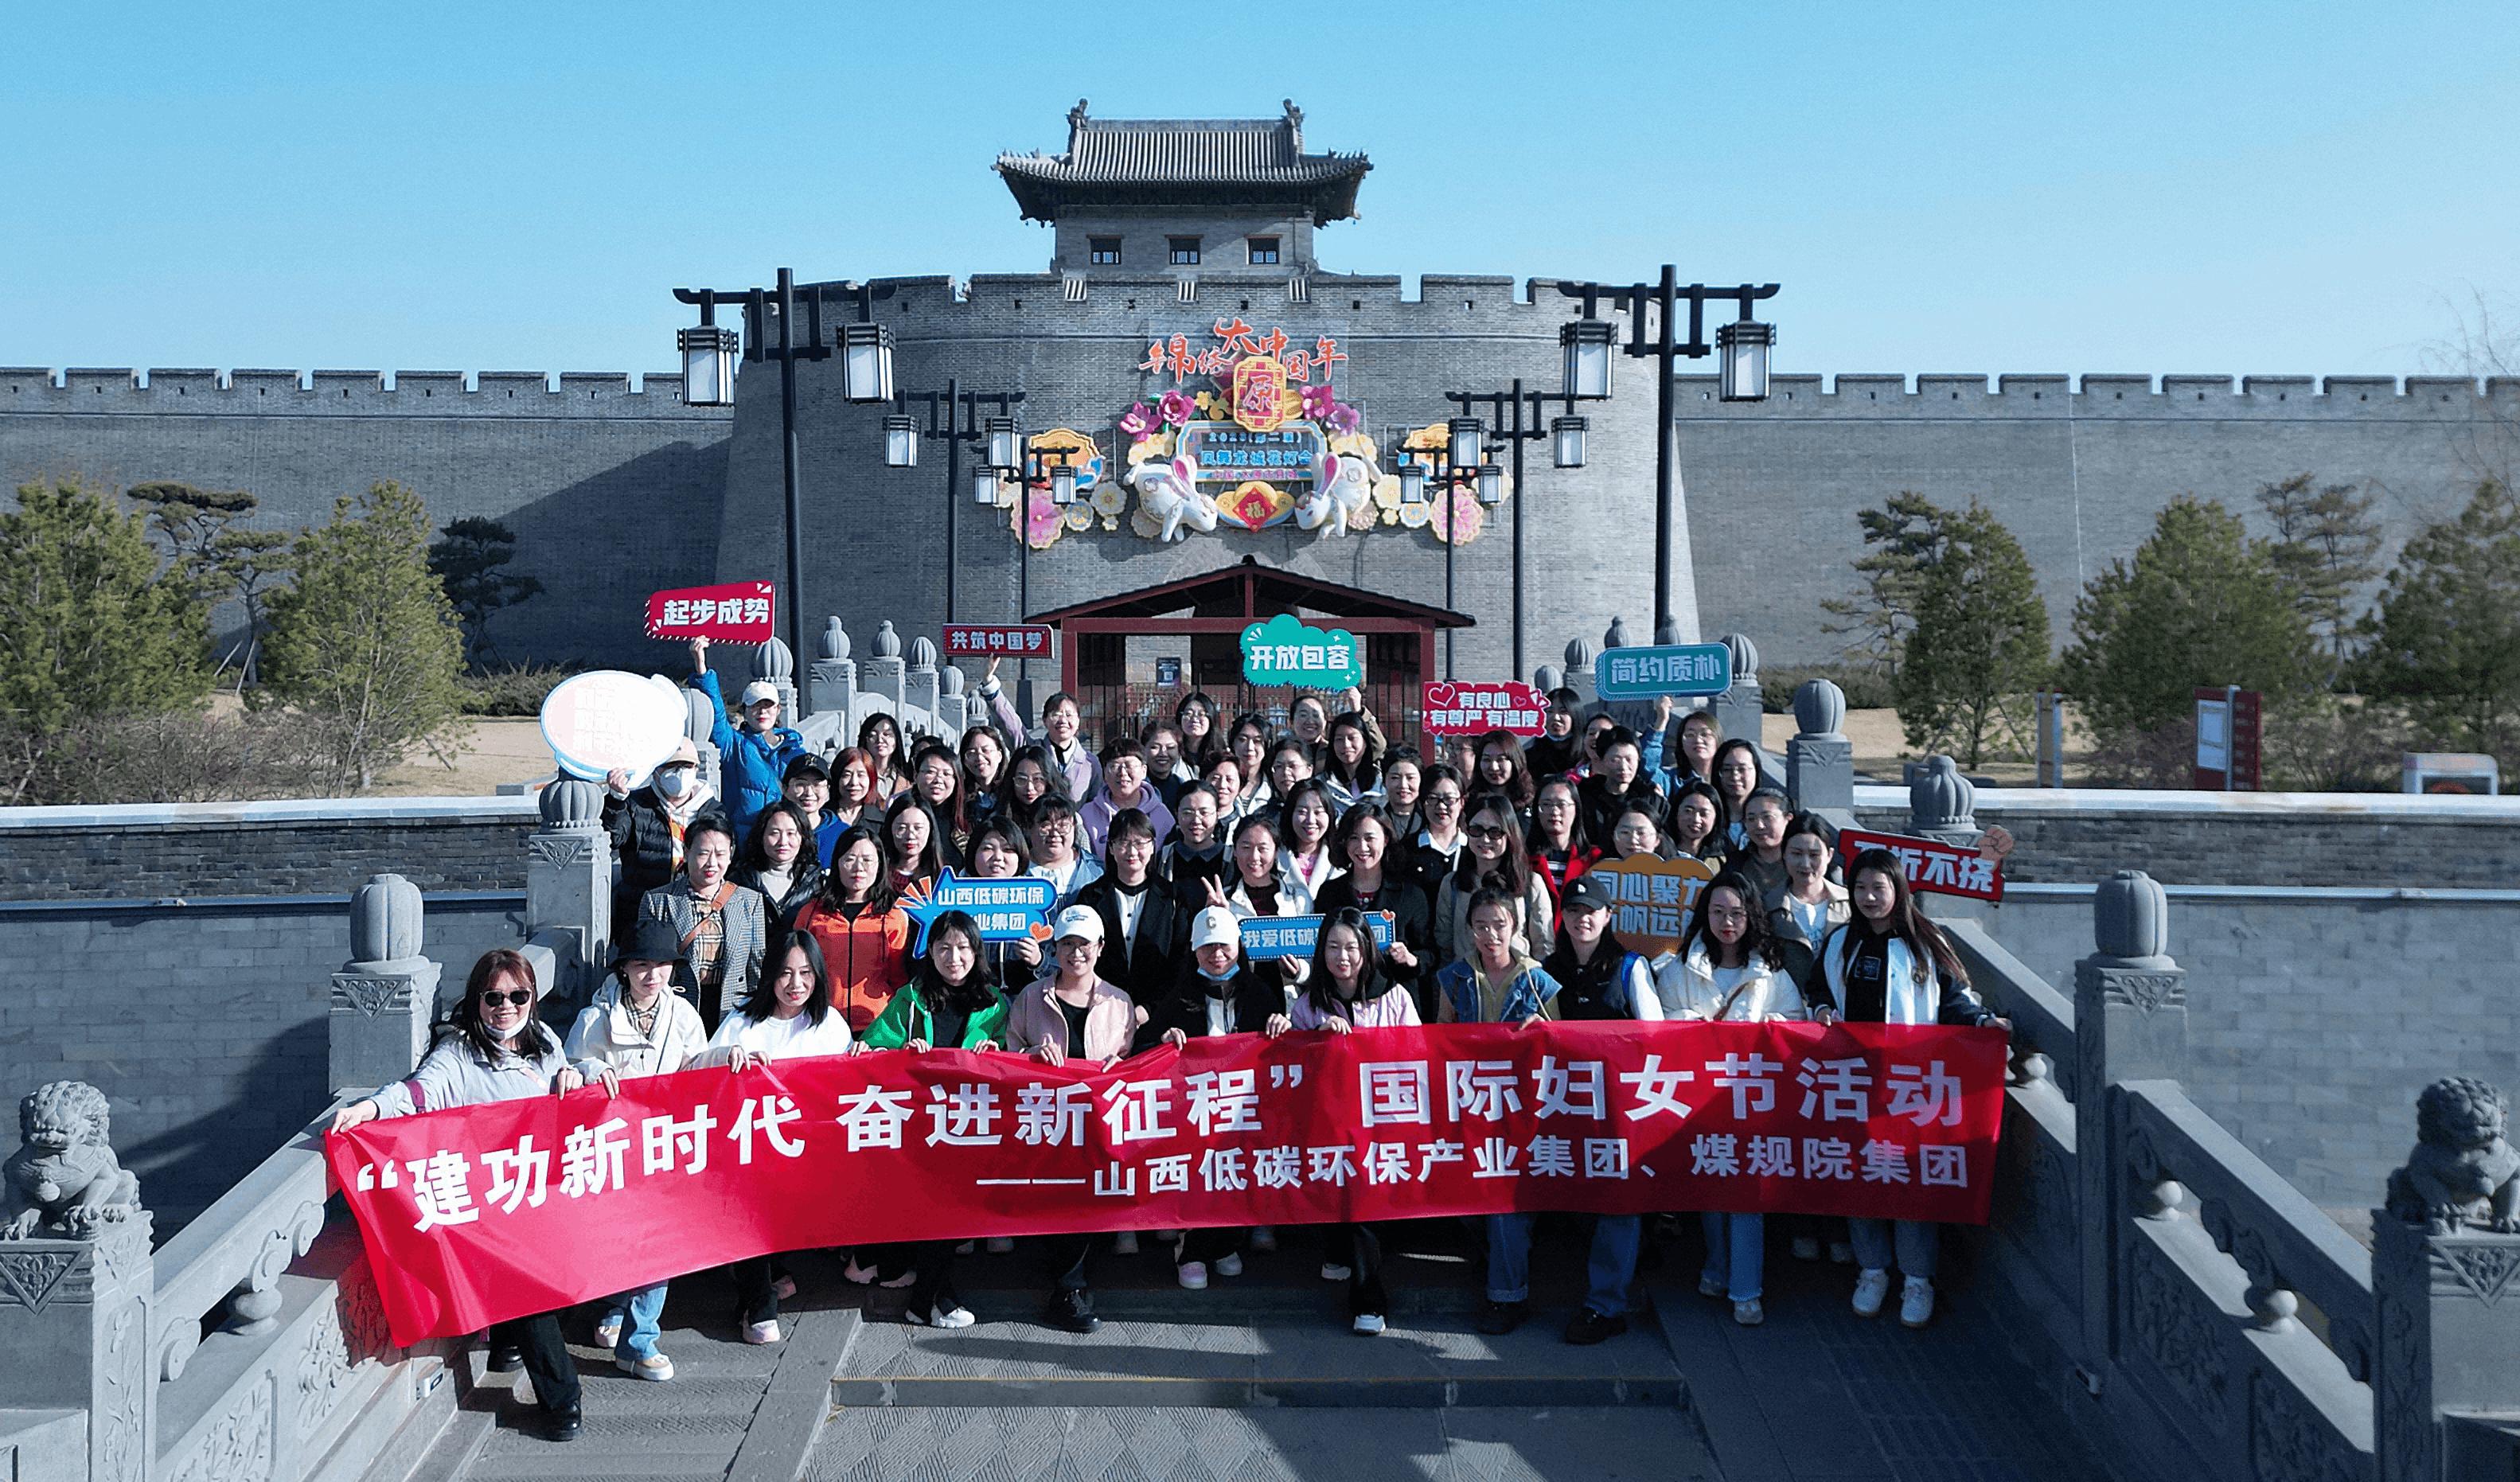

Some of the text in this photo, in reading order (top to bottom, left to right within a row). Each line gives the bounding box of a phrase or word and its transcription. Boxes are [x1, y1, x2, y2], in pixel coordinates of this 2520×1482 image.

[663, 598, 770, 626] 起步成势
[951, 630, 1043, 650] 共筑中国梦
[1250, 645, 1350, 670] 开放包容
[1611, 653, 1722, 684] 简约质朴
[1458, 692, 1511, 708] 有良心
[1430, 709, 1539, 727] 有尊严 有温度
[1855, 840, 1995, 893] 折不挠
[938, 887, 1044, 906] 山西低碳环保
[969, 913, 1026, 931] 业集团
[1611, 903, 1694, 938] 帆远
[1359, 1052, 1964, 1129] 国际妇女节活动
